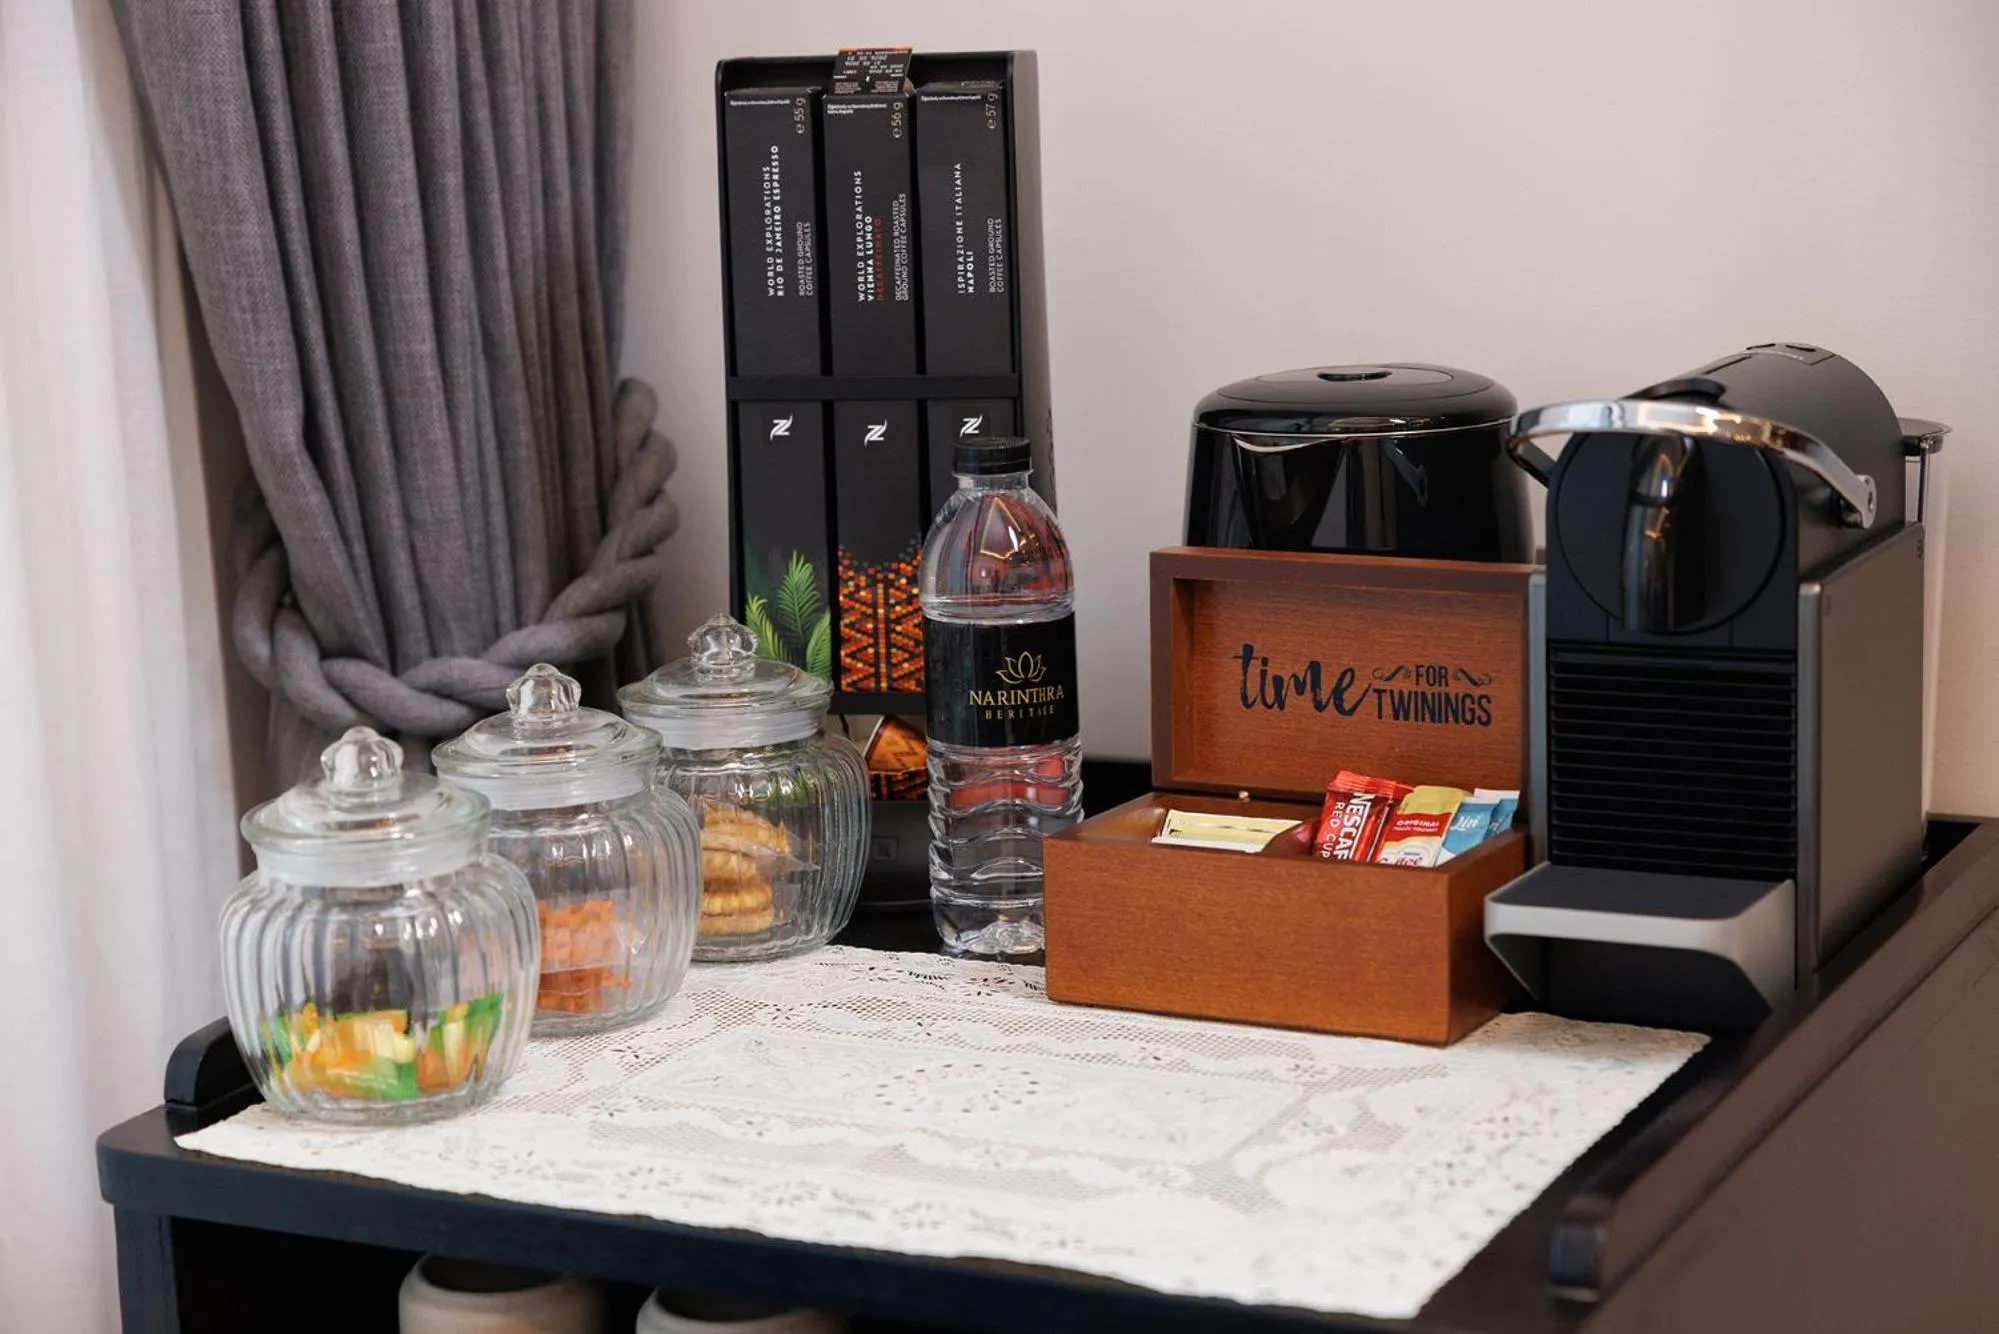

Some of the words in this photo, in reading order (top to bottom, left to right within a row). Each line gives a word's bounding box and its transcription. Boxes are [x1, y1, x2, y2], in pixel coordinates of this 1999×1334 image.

[794, 108, 804, 121] 55
[795, 98, 805, 106] g
[891, 112, 901, 125] 56
[893, 102, 903, 110] g
[986, 104, 996, 117] 57
[771, 145, 781, 200] ESPRESSO
[954, 163, 963, 215] ITALIANA
[762, 166, 773, 251] EXPLORATIONS
[854, 171, 864, 256] EXPLORATIONS
[892, 201, 900, 236] ROASTED
[898, 193, 907, 233] CAPSULES
[774, 205, 783, 253] JANEIRO
[796, 222, 805, 257] GROUND
[804, 222, 812, 263] CAPSULES
[865, 216, 873, 254] LUNGO
[987, 218, 995, 253] GROUND
[995, 219, 1003, 259] CAPSULES
[775, 258, 783, 271] DE
[874, 218, 884, 301] DECAFFEINATO
[899, 235, 908, 264] COFFEE
[956, 220, 966, 293] ISPIRAZIONE
[766, 256, 775, 296] WORLD
[776, 277, 784, 296] RIO
[797, 259, 806, 296] ROASTED
[805, 265, 813, 296] COFFEE
[857, 261, 865, 301] WORLD
[866, 259, 874, 301] VIENNA
[893, 238, 902, 300] DECAFFEINATED
[901, 266, 909, 300] GROUND
[966, 251, 975, 293] NAPOLI
[988, 255, 996, 292] ROASTED
[996, 262, 1004, 292] COFFEE
[1234, 643, 1373, 716] time
[1414, 664, 1449, 688] FOR
[969, 685, 1065, 706] NARINTHRA
[1372, 687, 1492, 727] TWININGS
[1328, 801, 1347, 829] RED
[1320, 832, 1337, 859] CUP
